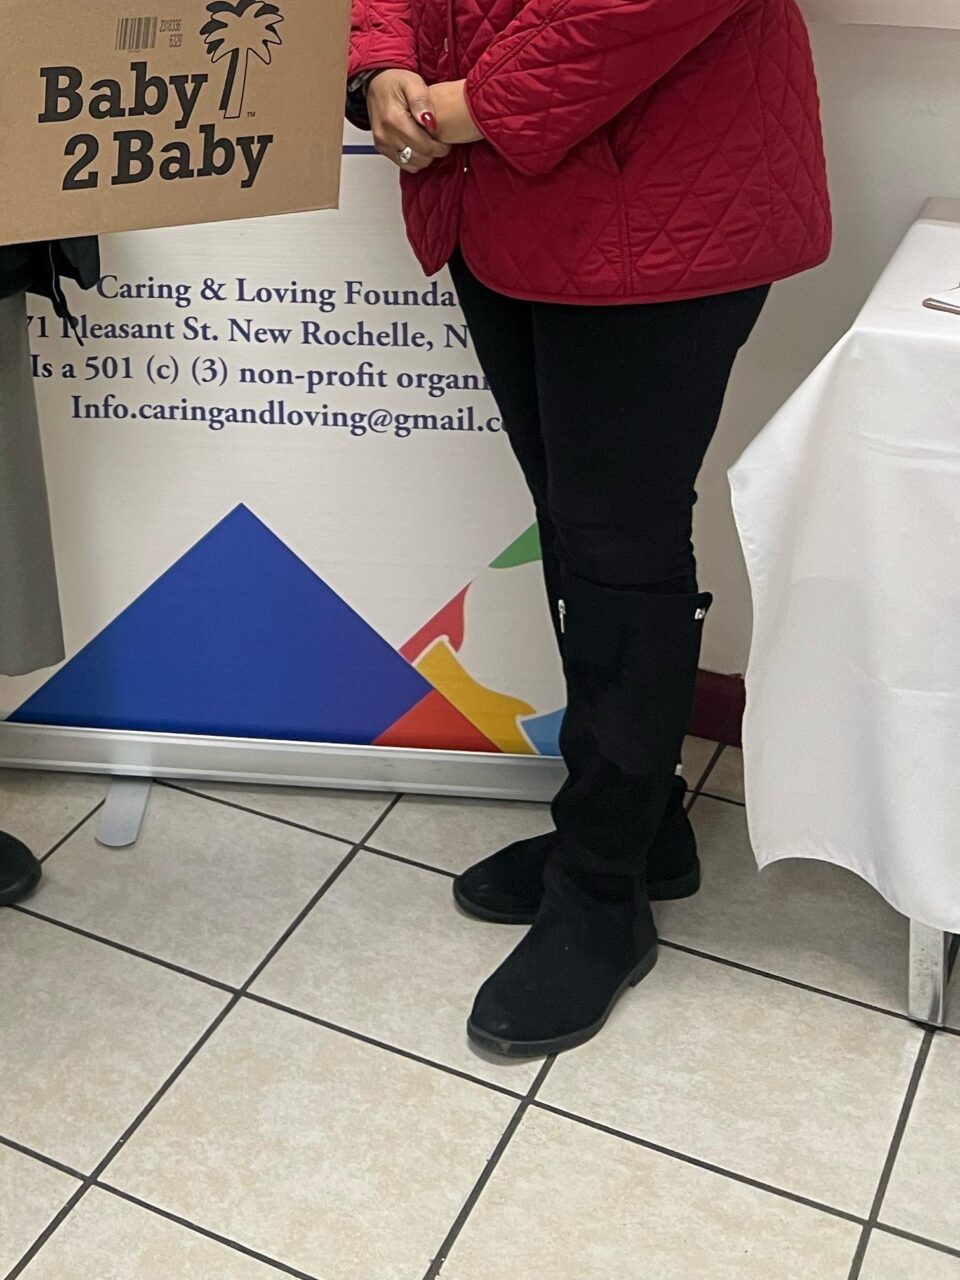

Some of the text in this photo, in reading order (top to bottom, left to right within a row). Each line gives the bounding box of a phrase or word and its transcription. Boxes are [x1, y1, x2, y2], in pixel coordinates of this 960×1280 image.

[38, 61, 208, 129] Baby
[62, 123, 274, 191] 2 Baby
[96, 274, 459, 312] Caring & Loving Founda
[183, 317, 218, 342] St.
[227, 319, 293, 345] New
[301, 319, 434, 351] Rochelle,
[30, 354, 53, 378] Is
[61, 362, 76, 379] a
[85, 356, 134, 380] 501
[146, 354, 179, 385] (c)
[192, 356, 229, 386] (3)
[238, 362, 388, 393] non-profit
[71, 394, 504, 437] Info.caringandloving@gmail.c
